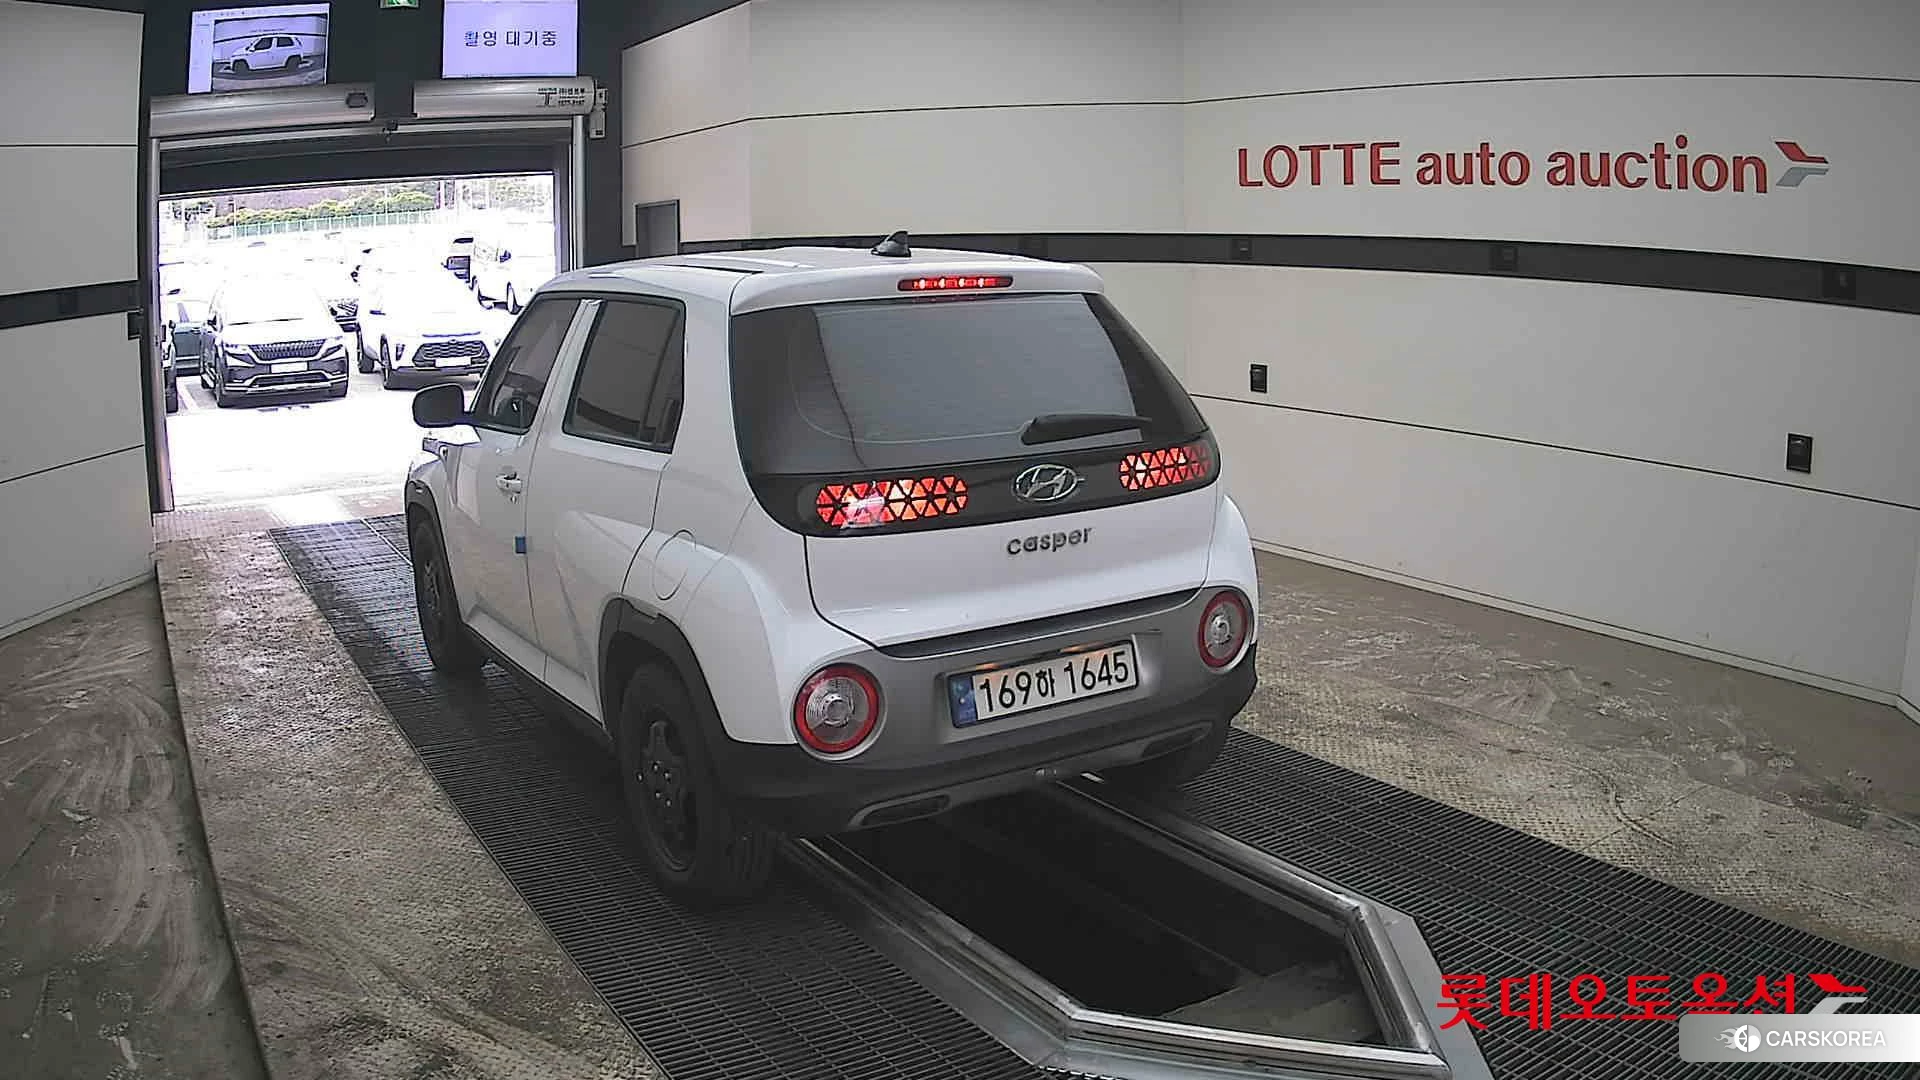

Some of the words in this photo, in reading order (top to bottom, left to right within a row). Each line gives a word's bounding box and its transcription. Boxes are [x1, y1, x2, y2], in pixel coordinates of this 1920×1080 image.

[505, 30, 558, 47] 대기중
[1238, 141, 1401, 188] LOTTE
[1416, 141, 1530, 186] auto
[1547, 134, 1768, 193] auction
[1007, 527, 1092, 556] casper
[979, 667, 1056, 713] 169하
[1063, 650, 1129, 694] 1645
